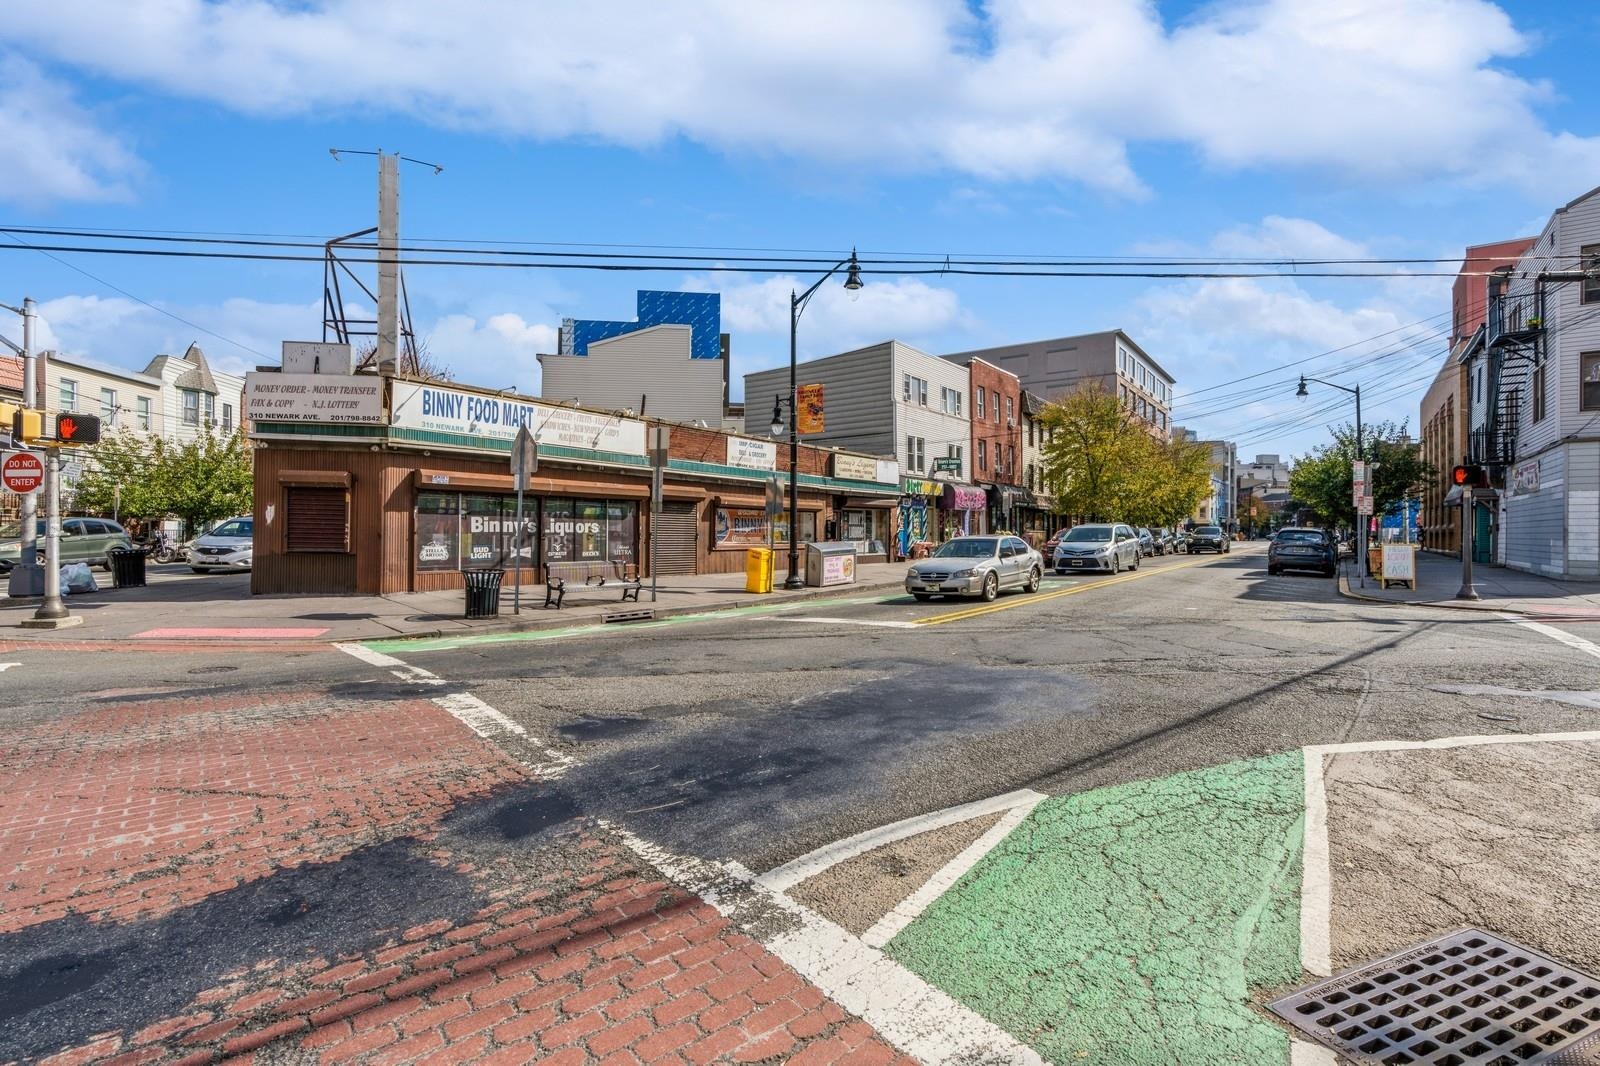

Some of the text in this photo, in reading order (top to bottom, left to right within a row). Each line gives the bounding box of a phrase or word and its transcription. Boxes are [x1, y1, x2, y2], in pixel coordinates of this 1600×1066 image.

[253, 384, 281, 393] MONEY
[281, 385, 306, 394] ORDER
[312, 385, 339, 394] MONEY
[340, 386, 377, 395] TRANSFER
[250, 398, 266, 407] FAX
[266, 399, 273, 408] &
[274, 400, 294, 408] COPY
[327, 400, 360, 409] LOTTERY
[422, 389, 534, 430] BINNY FOOD MART
[422, 421, 434, 429] 310
[435, 423, 464, 433] NEWARK
[9, 460, 37, 468] DO NOT
[10, 478, 35, 486] ENTER
[470, 516, 537, 537] Binny's
